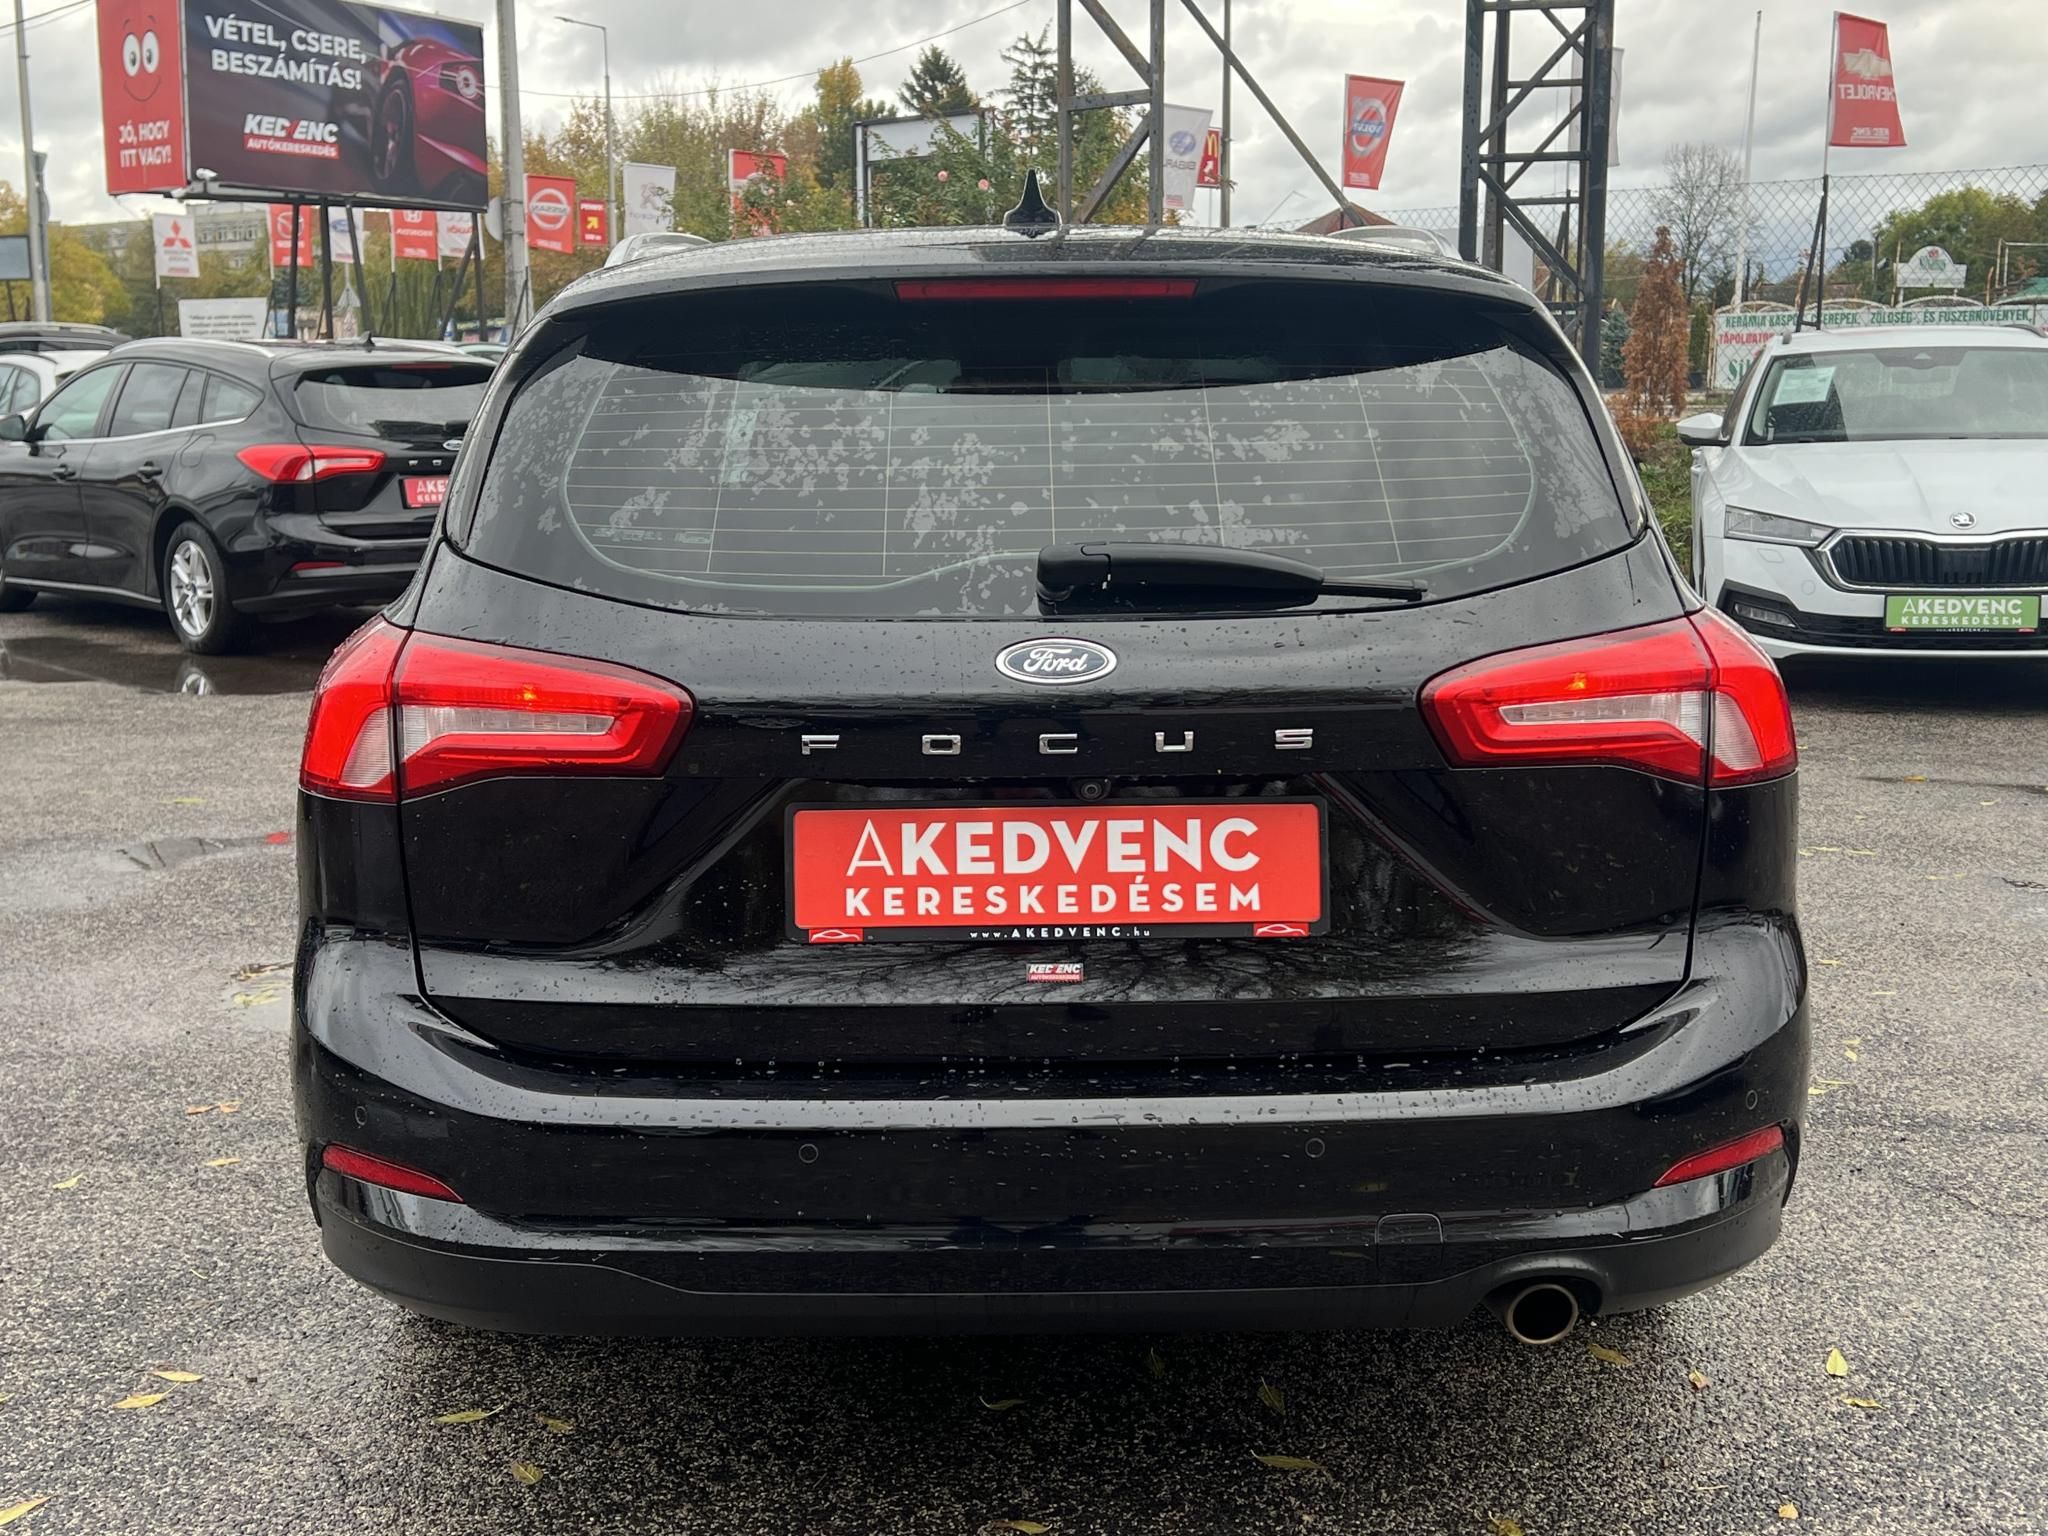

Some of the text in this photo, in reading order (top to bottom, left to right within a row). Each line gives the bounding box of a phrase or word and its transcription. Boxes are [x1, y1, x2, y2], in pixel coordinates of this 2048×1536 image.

[205, 14, 367, 64] VÉTEL, CSERE,
[211, 49, 363, 90] BESZÁMÍTÁS!
[119, 119, 170, 145] JÓ, HOGY
[120, 144, 172, 168] ITT VAGY!
[1923, 308, 1936, 323] ÉS
[1901, 613, 2023, 626] KERESKEDÉSEM
[1023, 647, 1089, 672] Ford
[801, 728, 1314, 756] FOCUS
[845, 875, 1261, 917] KERESKEDÉSEM
[970, 927, 1150, 939] www.AKEDVENC.hu
